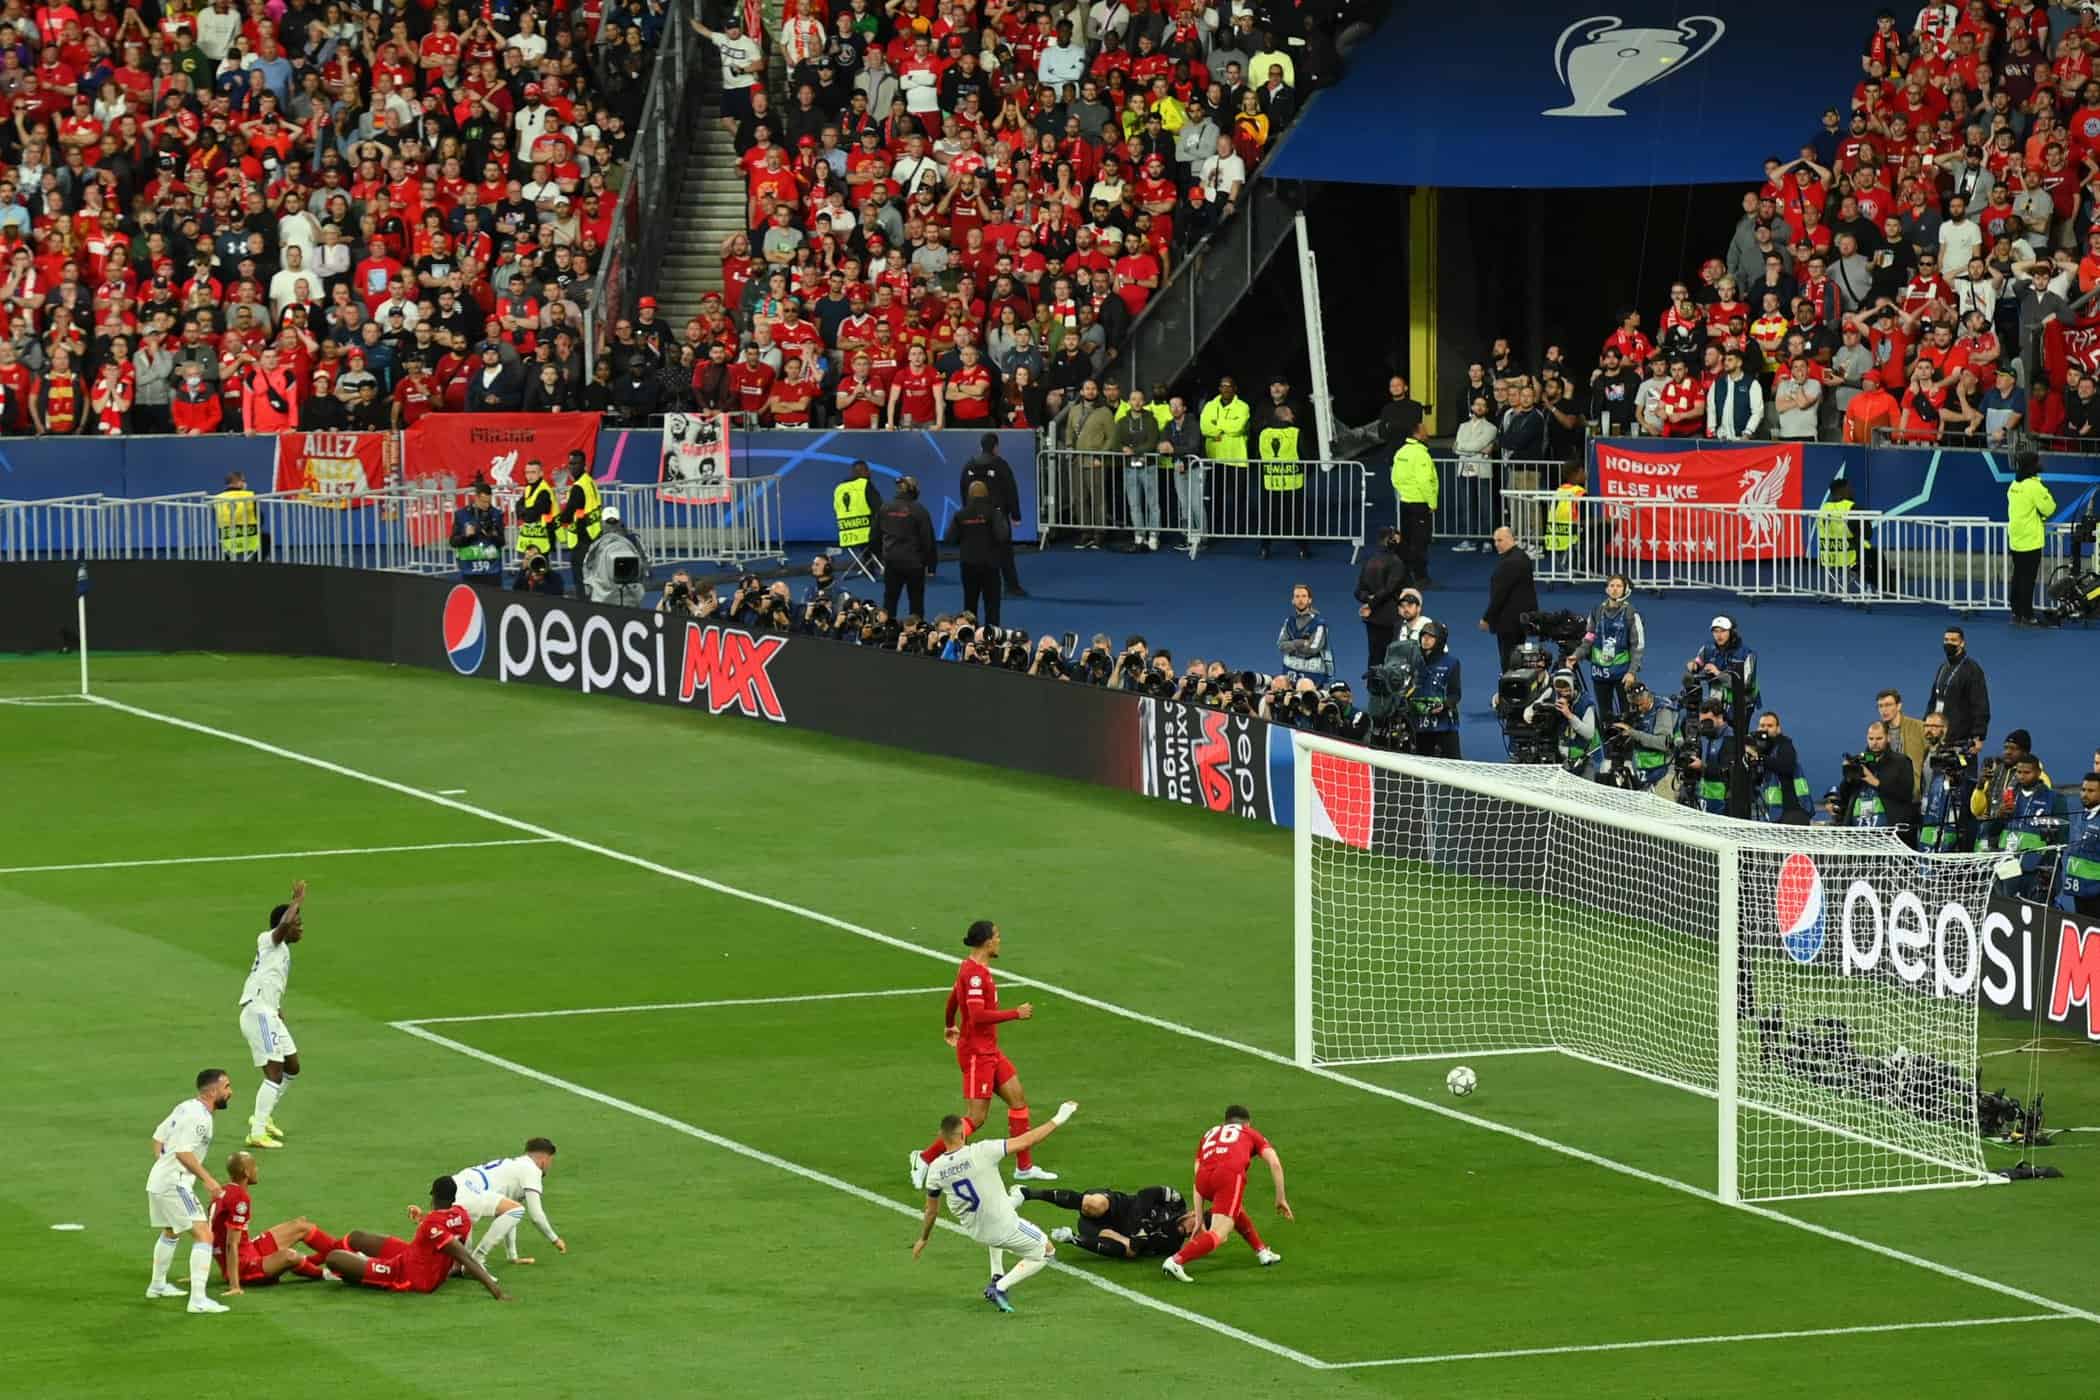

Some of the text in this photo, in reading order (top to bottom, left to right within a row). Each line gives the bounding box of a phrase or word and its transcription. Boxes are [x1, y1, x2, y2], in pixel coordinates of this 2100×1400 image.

[303, 433, 358, 457] ALLEZ
[1606, 455, 1681, 476] NOBODY
[1607, 480, 1698, 499] ELSE LIKE
[500, 604, 788, 723] pepsi MAX
[1842, 880, 2033, 1011] pepsi
[1202, 1123, 1242, 1151] 26
[952, 1178, 981, 1213] 9
